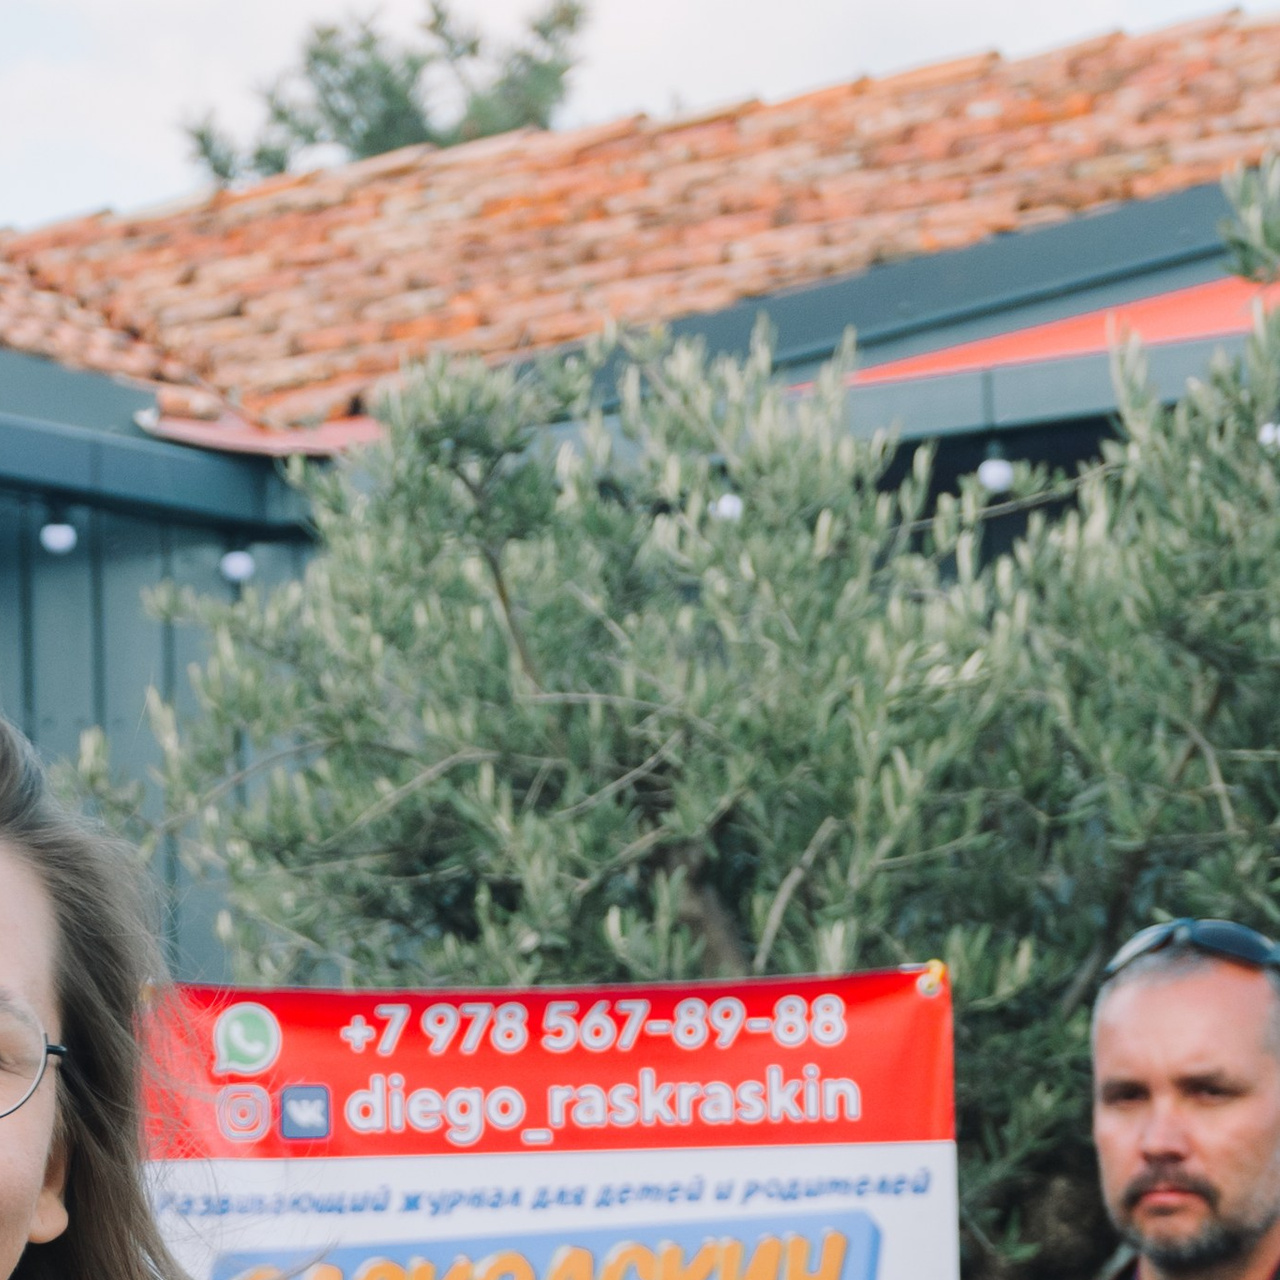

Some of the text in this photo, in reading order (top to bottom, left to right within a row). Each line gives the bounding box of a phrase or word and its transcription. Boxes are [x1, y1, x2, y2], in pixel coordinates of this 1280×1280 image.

[339, 993, 848, 1057] +7 978 567-89-88
[344, 1063, 863, 1146] diego_raskraskin
[594, 1174, 708, 1209] детей
[740, 1165, 932, 1205] родителей
